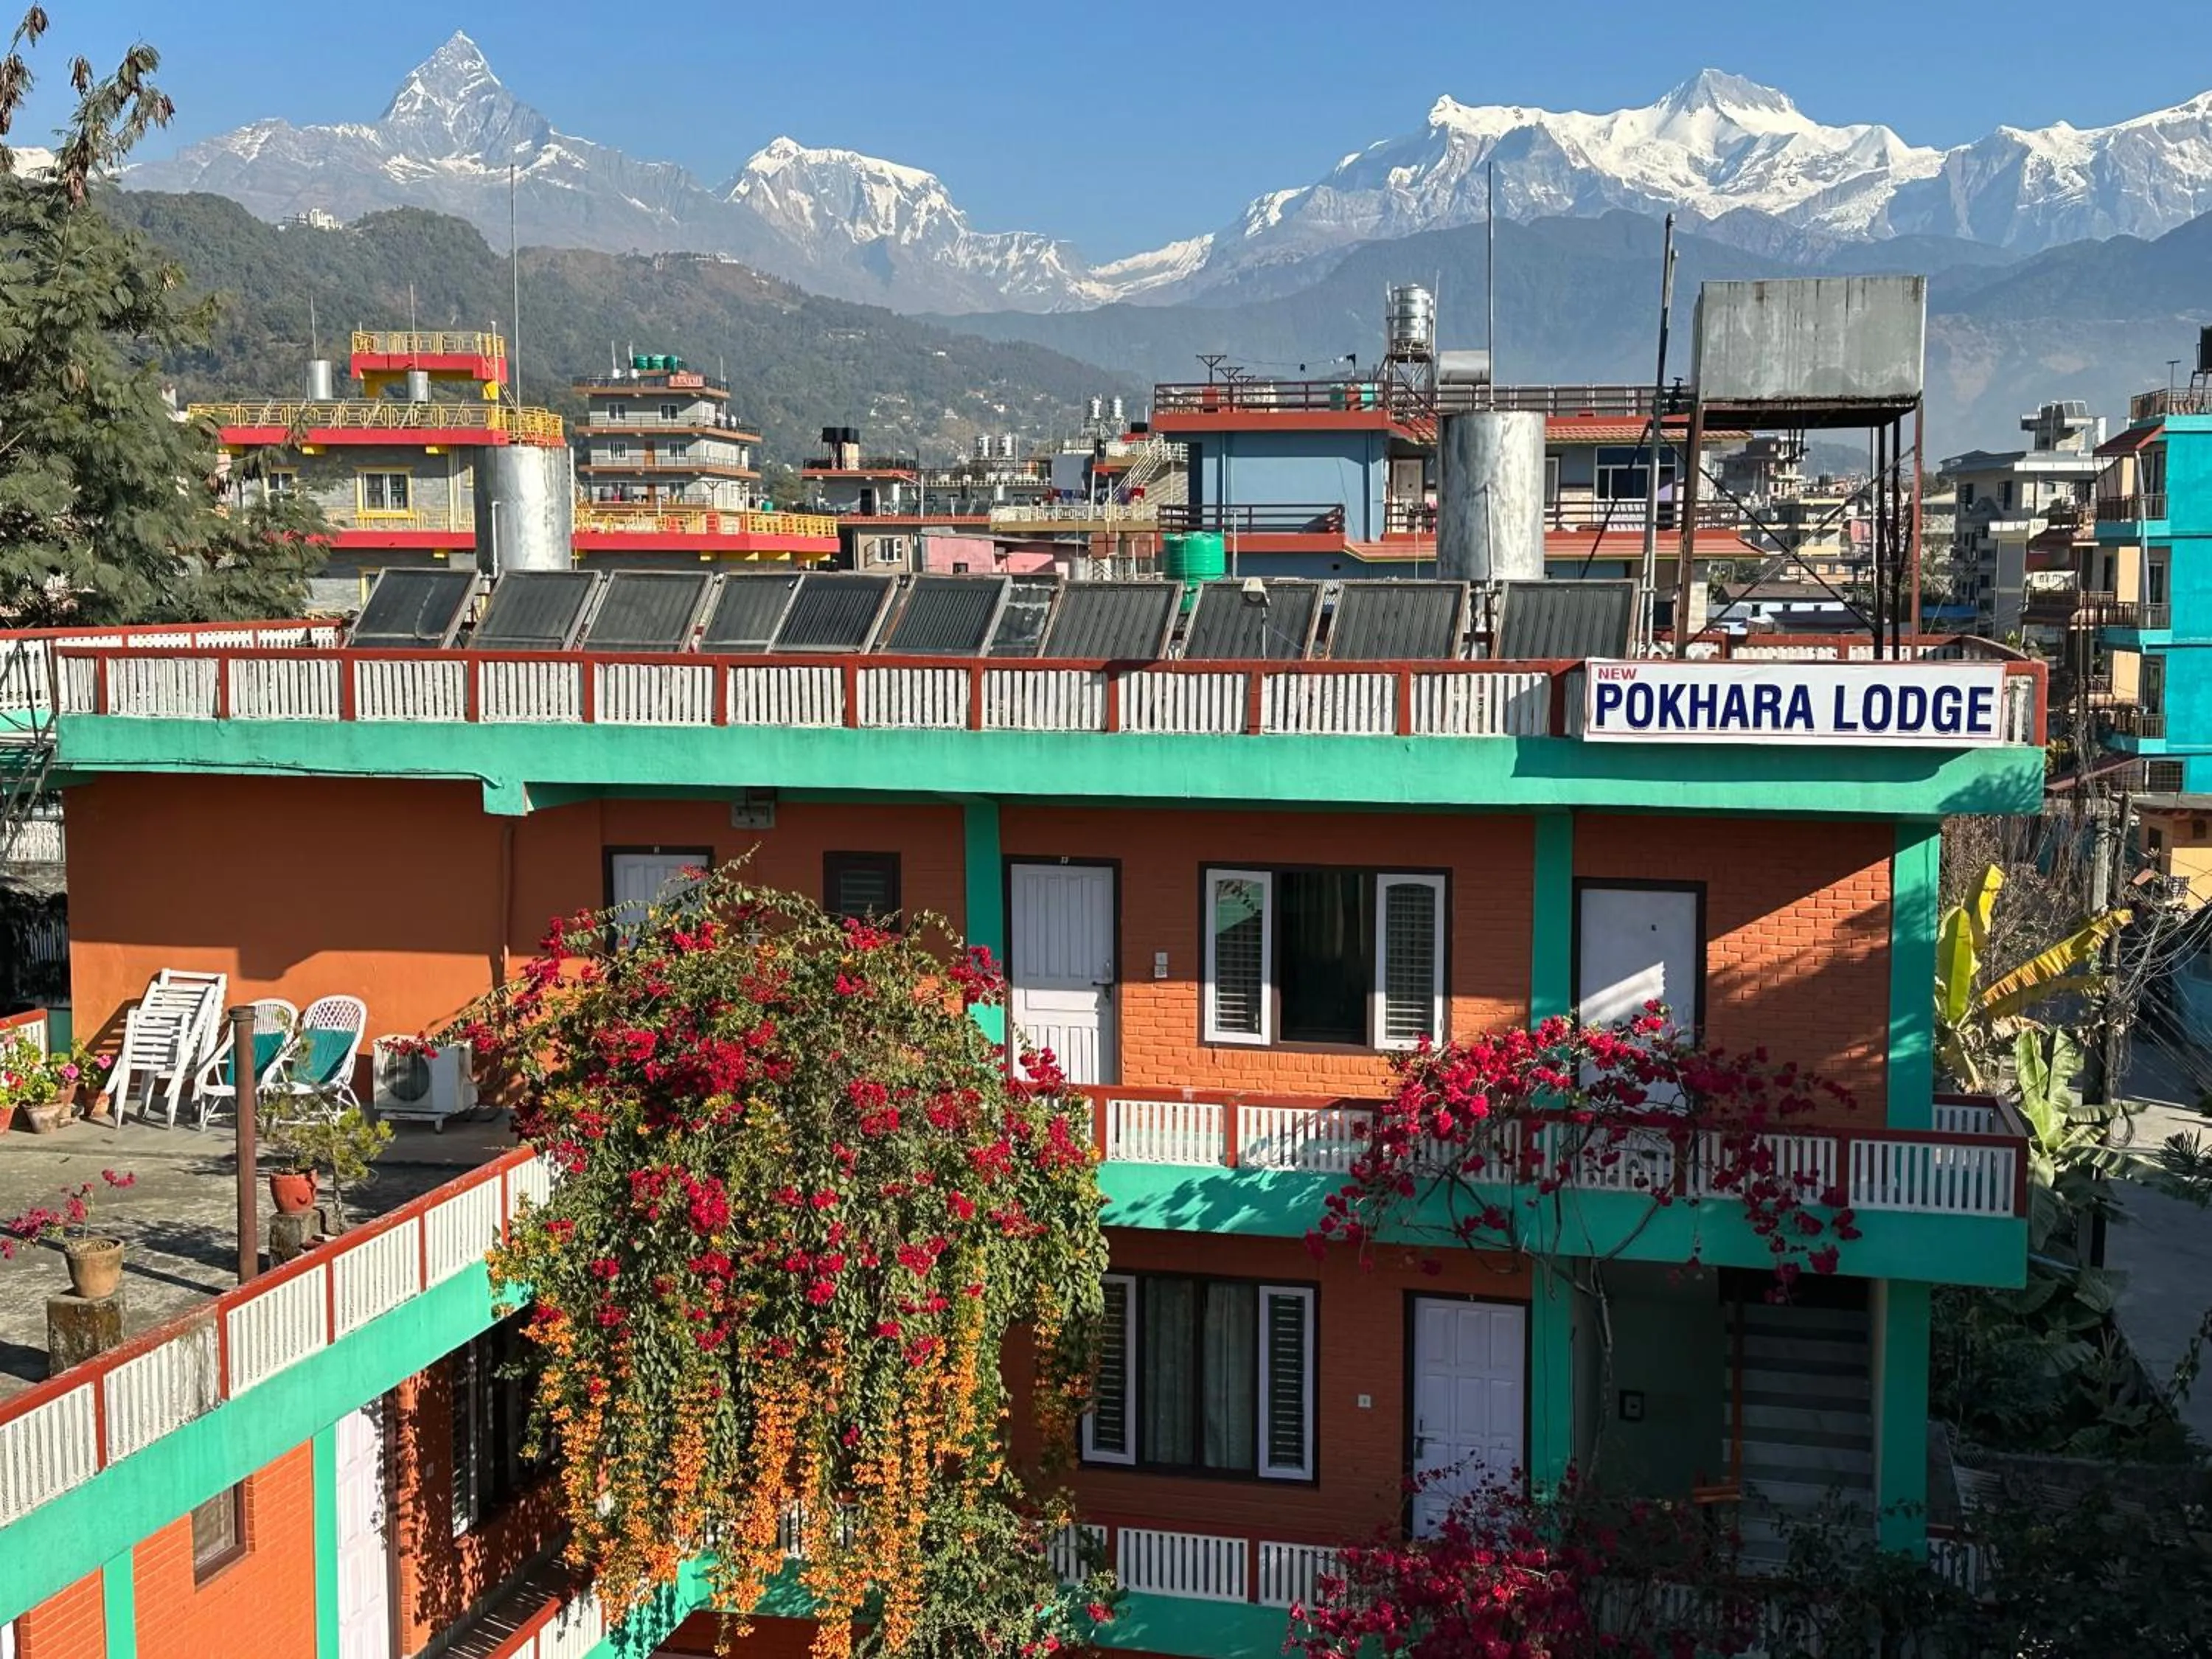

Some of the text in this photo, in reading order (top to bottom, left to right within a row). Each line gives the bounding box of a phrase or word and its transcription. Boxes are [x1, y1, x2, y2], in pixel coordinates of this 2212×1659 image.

[1598, 667, 1637, 680] NEW
[1596, 682, 1994, 733] POKHARA LODGE
